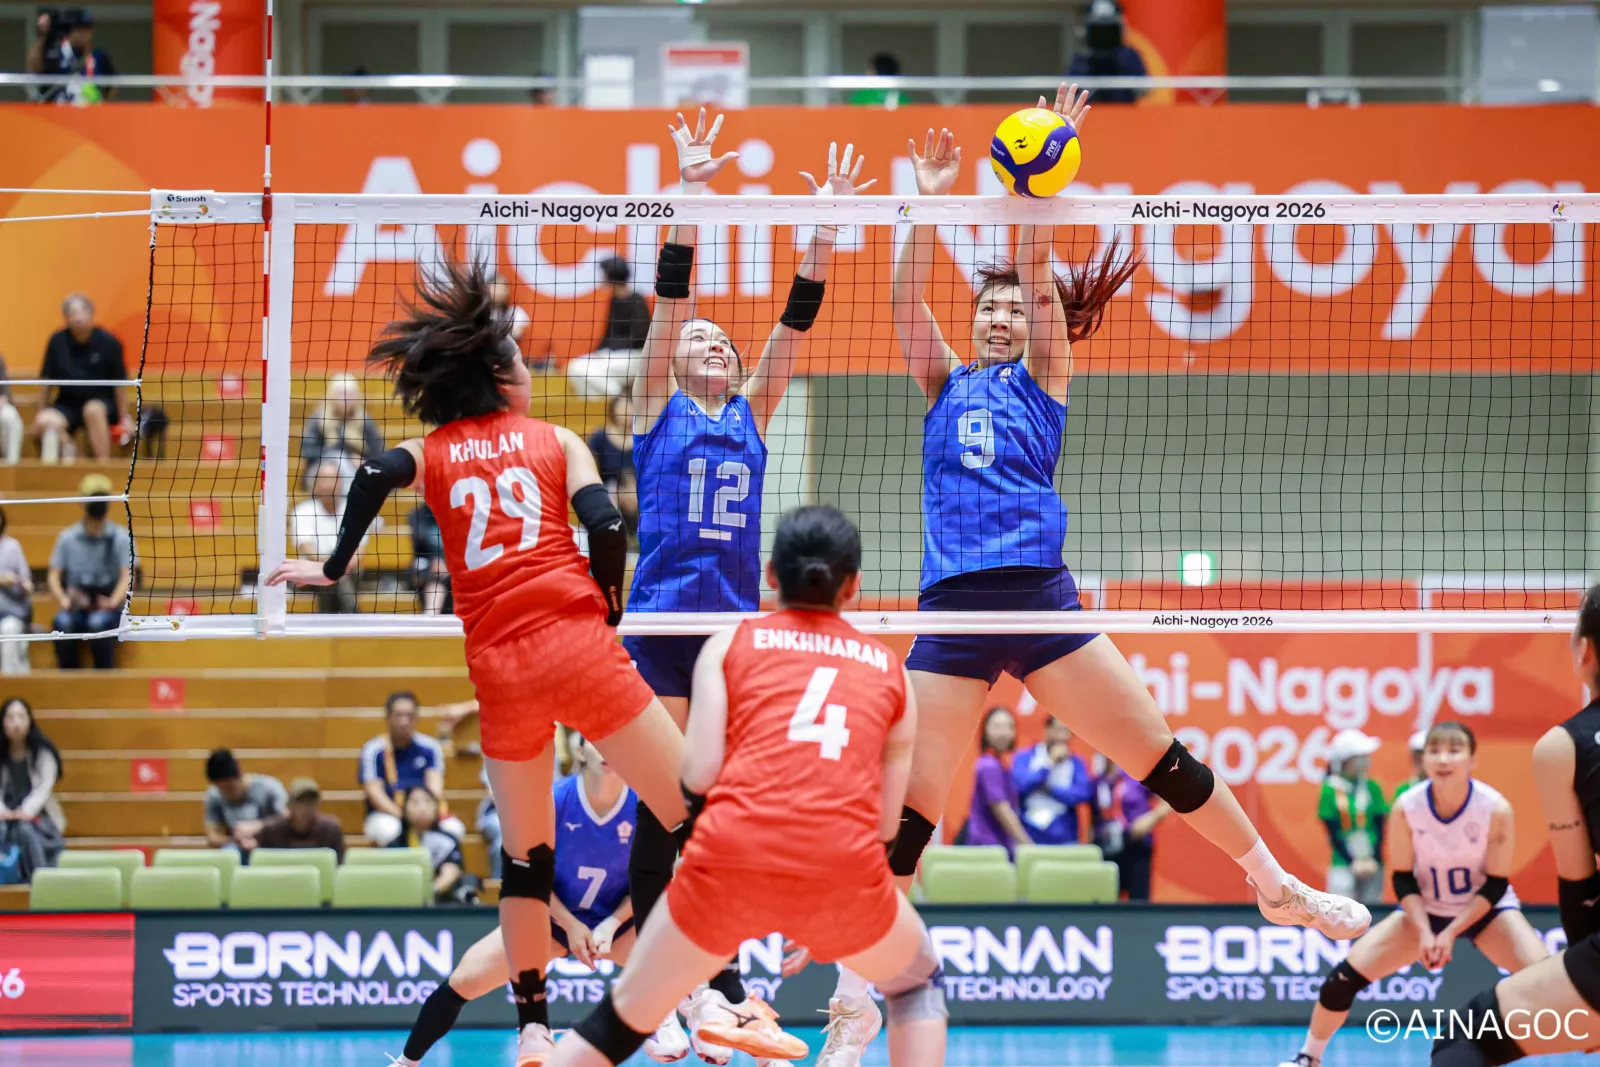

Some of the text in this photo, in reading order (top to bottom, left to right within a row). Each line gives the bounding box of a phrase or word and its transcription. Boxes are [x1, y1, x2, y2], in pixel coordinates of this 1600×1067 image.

[480, 201, 675, 222] Aichi-Nagoya 2026
[1131, 201, 1326, 222] Aichi-Nagoya 2026
[449, 432, 524, 463] KHULAN
[957, 408, 995, 470] 9
[687, 457, 751, 528] 12
[450, 467, 542, 571] 29
[1152, 614, 1273, 628] Aichi-Nagoya 2026
[753, 628, 889, 673] ENKHNARAN
[787, 666, 850, 761] 4
[1018, 651, 1495, 733] hi-Nagoya
[577, 866, 608, 909] 7
[1430, 865, 1472, 899] 10
[163, 929, 453, 979] BORNAN
[928, 925, 1113, 974] RNAN
[1155, 925, 1443, 974] BORN
[0, 967, 25, 999] 6
[173, 979, 439, 1007] SPORTS TECHNOLOG
[943, 976, 1113, 1000] TECHNOLOGY
[1165, 975, 1444, 1001] SPORTS TECOLOGY
